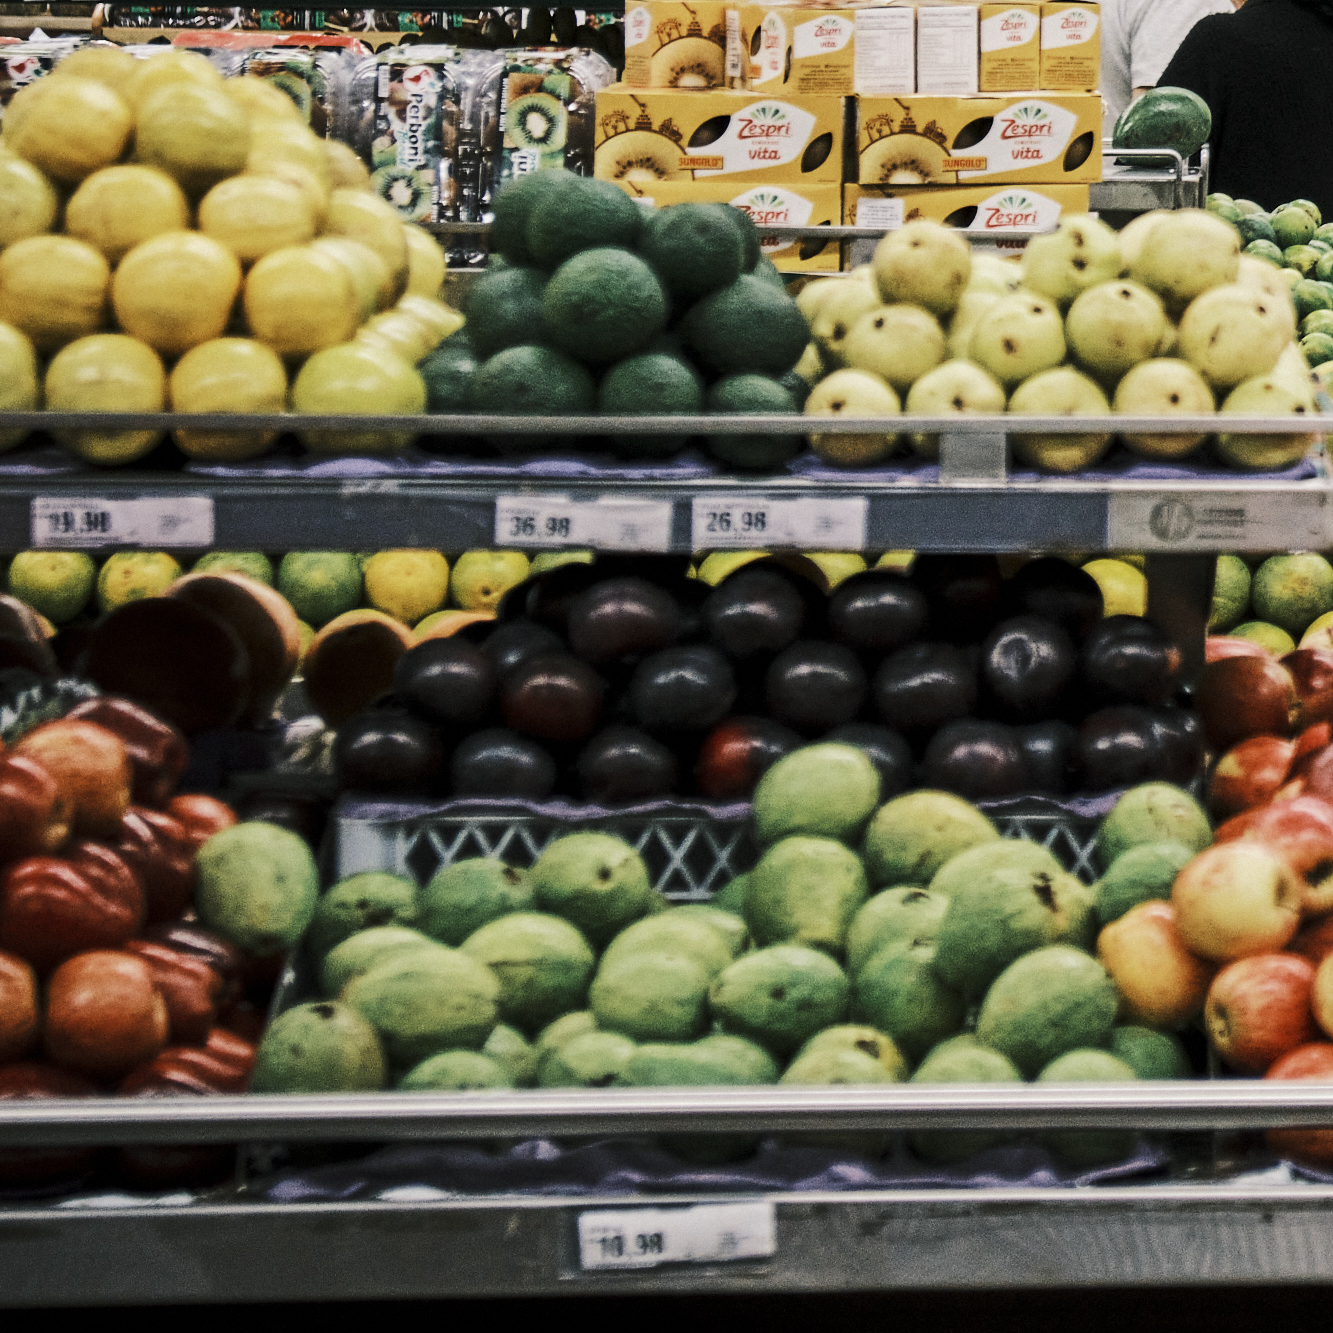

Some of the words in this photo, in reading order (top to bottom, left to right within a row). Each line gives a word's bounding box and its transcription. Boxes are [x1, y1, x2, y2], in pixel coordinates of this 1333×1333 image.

[1000, 19, 1027, 31] Zespri
[1061, 17, 1087, 30] Zespri
[814, 25, 842, 39] Zespri
[408, 93, 424, 164] Perboni
[737, 118, 791, 140] Zespri
[1000, 119, 1053, 140] Zespri
[749, 148, 781, 160] vita
[1011, 147, 1043, 160] vita
[985, 207, 1040, 229] Zespri
